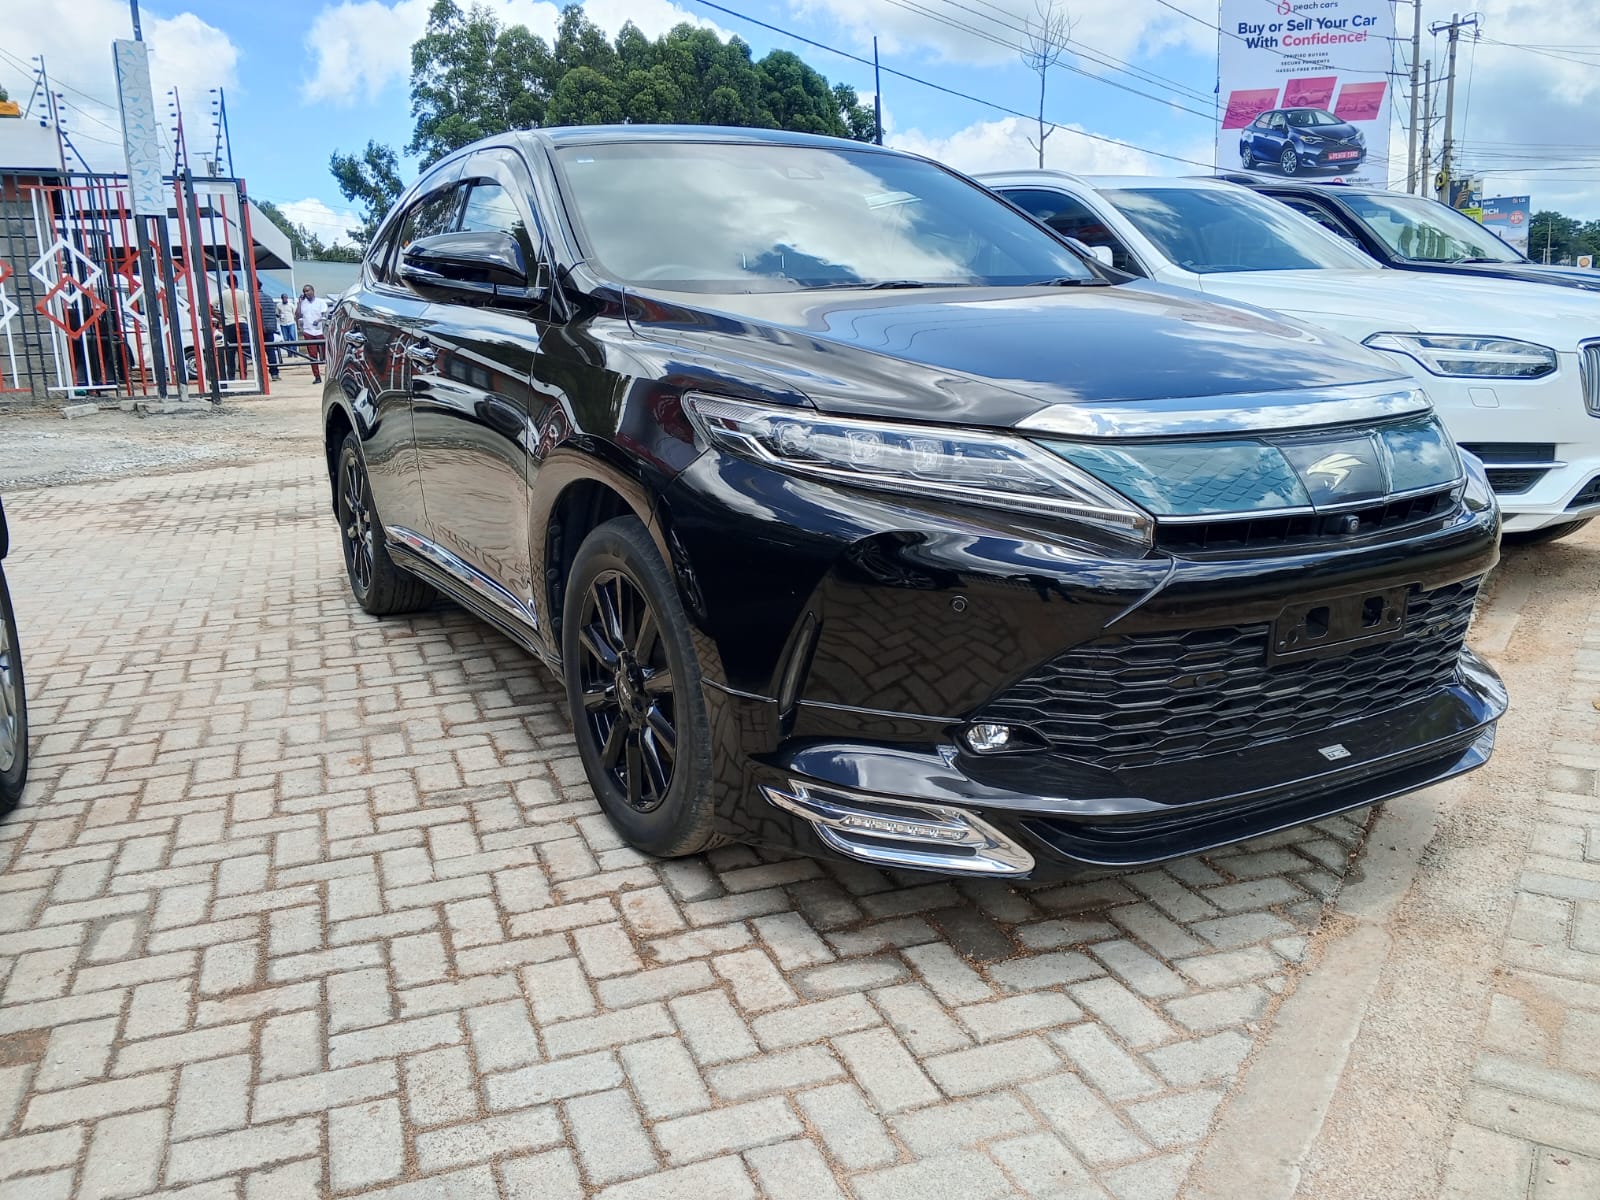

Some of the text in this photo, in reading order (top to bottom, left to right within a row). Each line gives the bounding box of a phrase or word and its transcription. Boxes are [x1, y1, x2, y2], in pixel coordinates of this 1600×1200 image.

[1293, 1, 1338, 12] peach cars
[1238, 15, 1377, 36] Buy or Sell Your Car
[1246, 30, 1367, 49] With Confidence!
